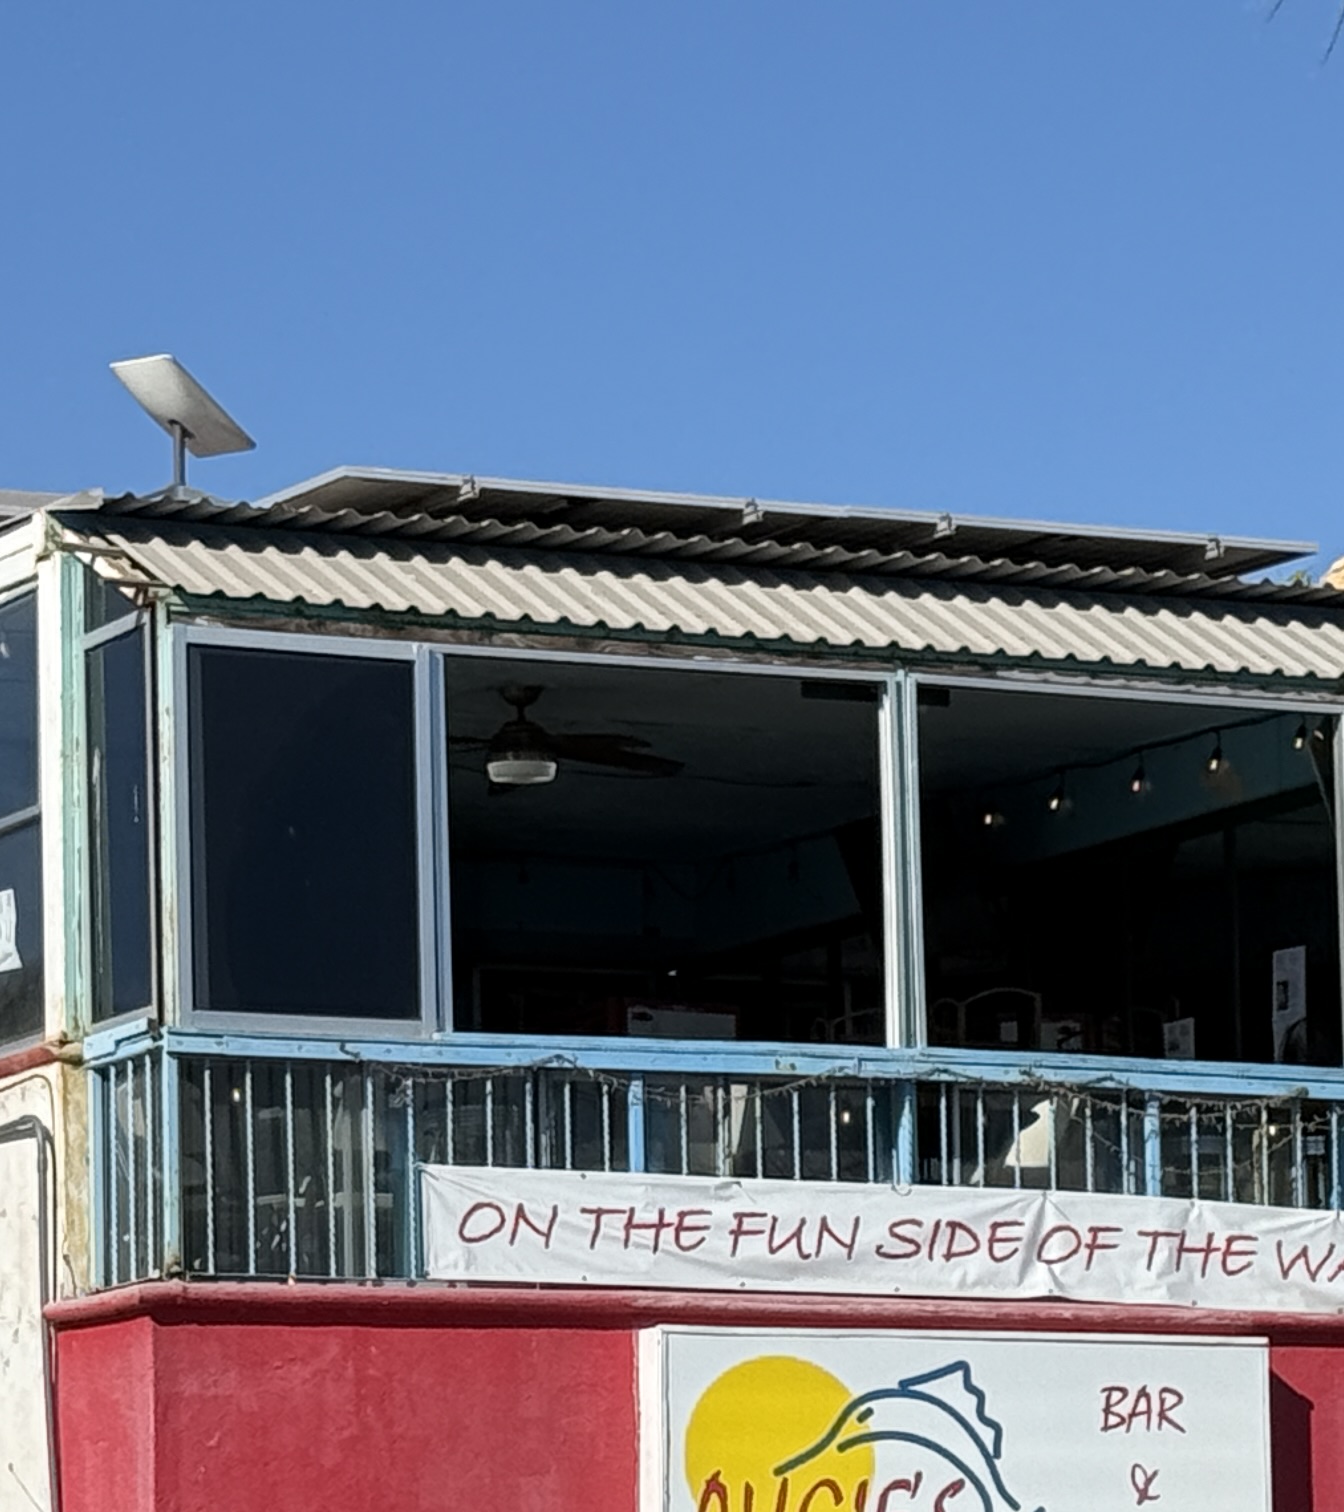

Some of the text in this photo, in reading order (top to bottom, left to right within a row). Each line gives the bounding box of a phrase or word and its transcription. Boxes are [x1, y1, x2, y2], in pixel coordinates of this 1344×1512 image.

[457, 1201, 557, 1249] ON
[581, 1204, 708, 1255] THE
[729, 1210, 860, 1260] FUN
[874, 1215, 1021, 1265] SIDE
[1036, 1225, 1120, 1271] OF
[1136, 1229, 1258, 1279] THE
[1100, 1385, 1186, 1434] BAR
[1131, 1463, 1160, 1505] &
